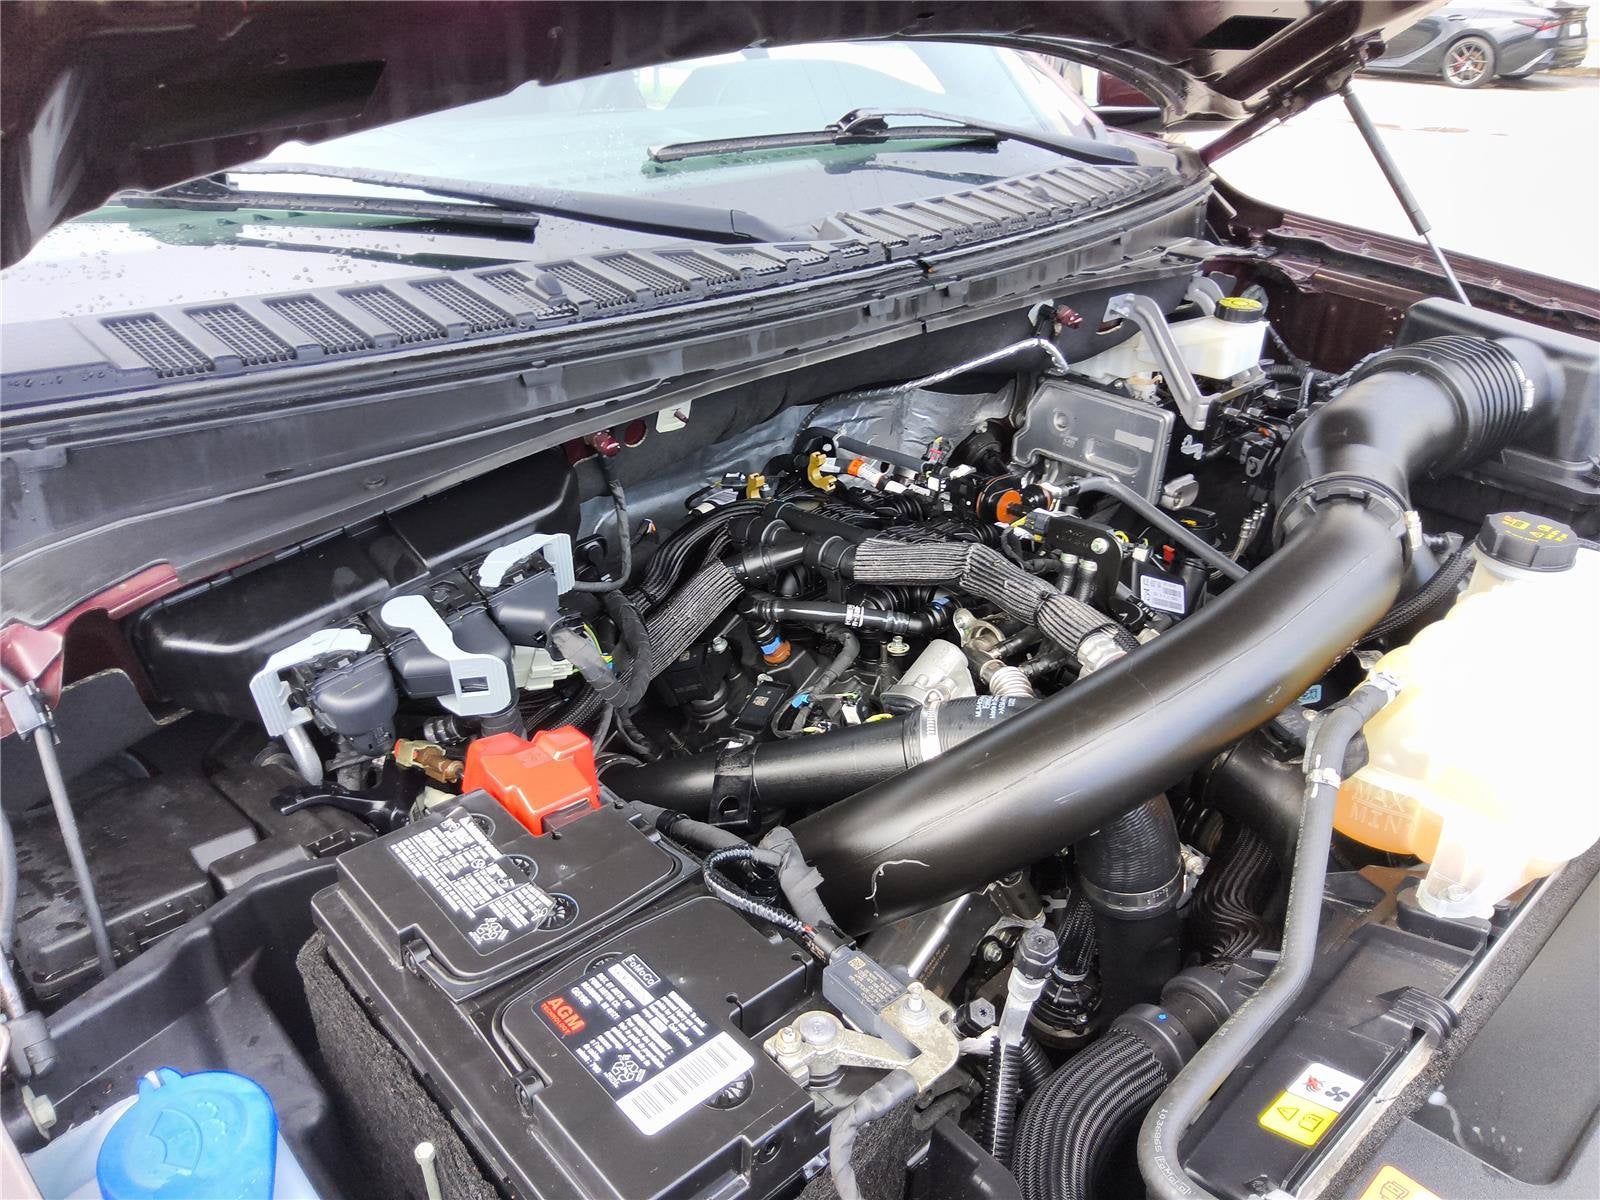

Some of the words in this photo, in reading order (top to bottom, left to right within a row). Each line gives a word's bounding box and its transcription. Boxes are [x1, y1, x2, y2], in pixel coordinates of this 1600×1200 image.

[1353, 781, 1407, 811] MAX
[1353, 806, 1398, 833] MIN
[624, 957, 656, 986] FoMoCo
[547, 996, 586, 1032] AGM
